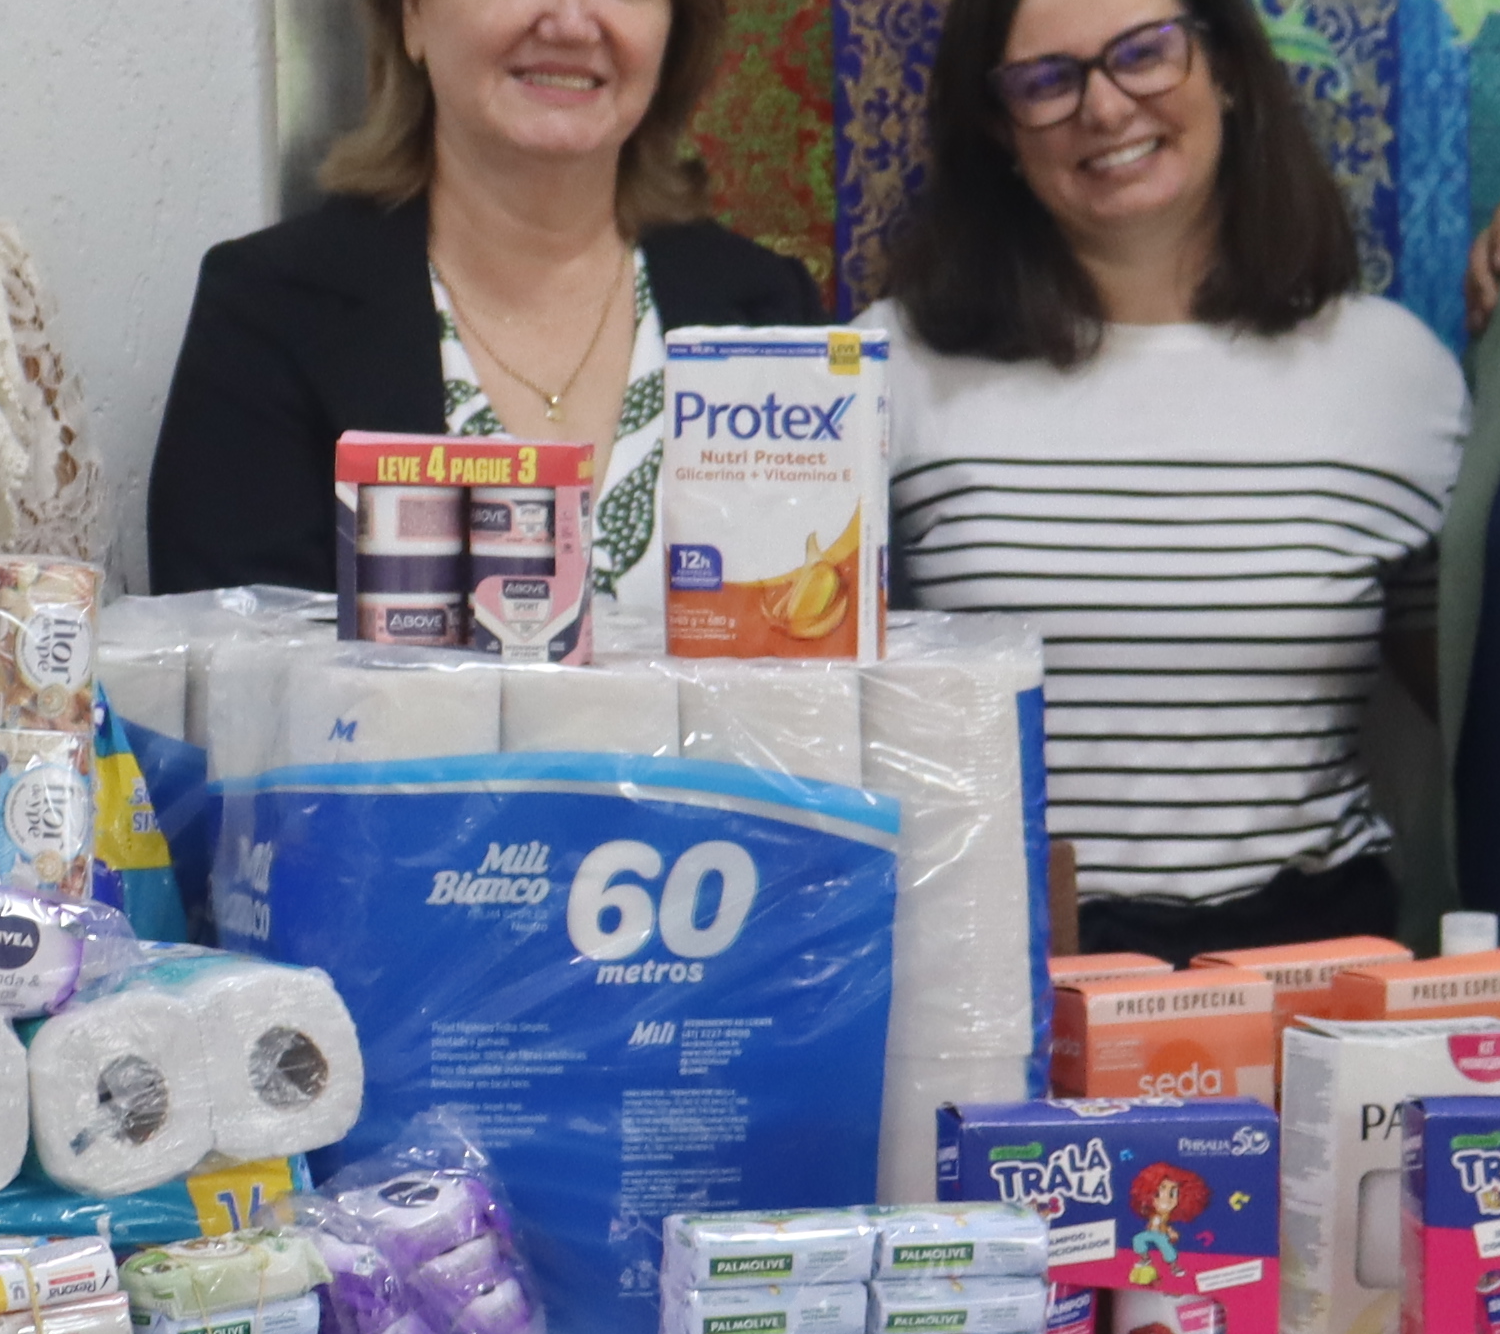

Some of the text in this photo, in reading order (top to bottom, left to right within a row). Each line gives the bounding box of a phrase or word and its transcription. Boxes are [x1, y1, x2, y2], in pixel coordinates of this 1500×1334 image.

[673, 391, 856, 441] Protex
[377, 445, 538, 485] LEVE 4 PAGUE 3
[700, 448, 827, 465] Nutri Protect
[675, 468, 852, 482] Glicerina + Vitamina E
[678, 550, 711, 569] 12h
[505, 583, 546, 595] ABOVE
[513, 601, 539, 612] SPORT
[389, 612, 443, 629] ABOVE
[52, 617, 82, 686] flor
[327, 717, 359, 743] M
[476, 840, 549, 875] Mili
[425, 870, 550, 906] Bianco
[566, 839, 758, 961] 60
[28, 972, 41, 988] &
[596, 958, 704, 985] metros
[1412, 982, 1459, 1002] PREÇO
[1116, 990, 1247, 1018] PREÇO ESPECIAL
[628, 1020, 677, 1047] Mili
[1138, 1063, 1223, 1097] seda
[995, 1152, 1073, 1201] TRÁ
[900, 1247, 967, 1261] PALMOLIVE
[717, 1258, 786, 1274] PALMOLIVE
[47, 1279, 98, 1300] Rexona
[710, 1316, 780, 1332] PALMOLIVE
[893, 1315, 962, 1327] PALMOLIVE
